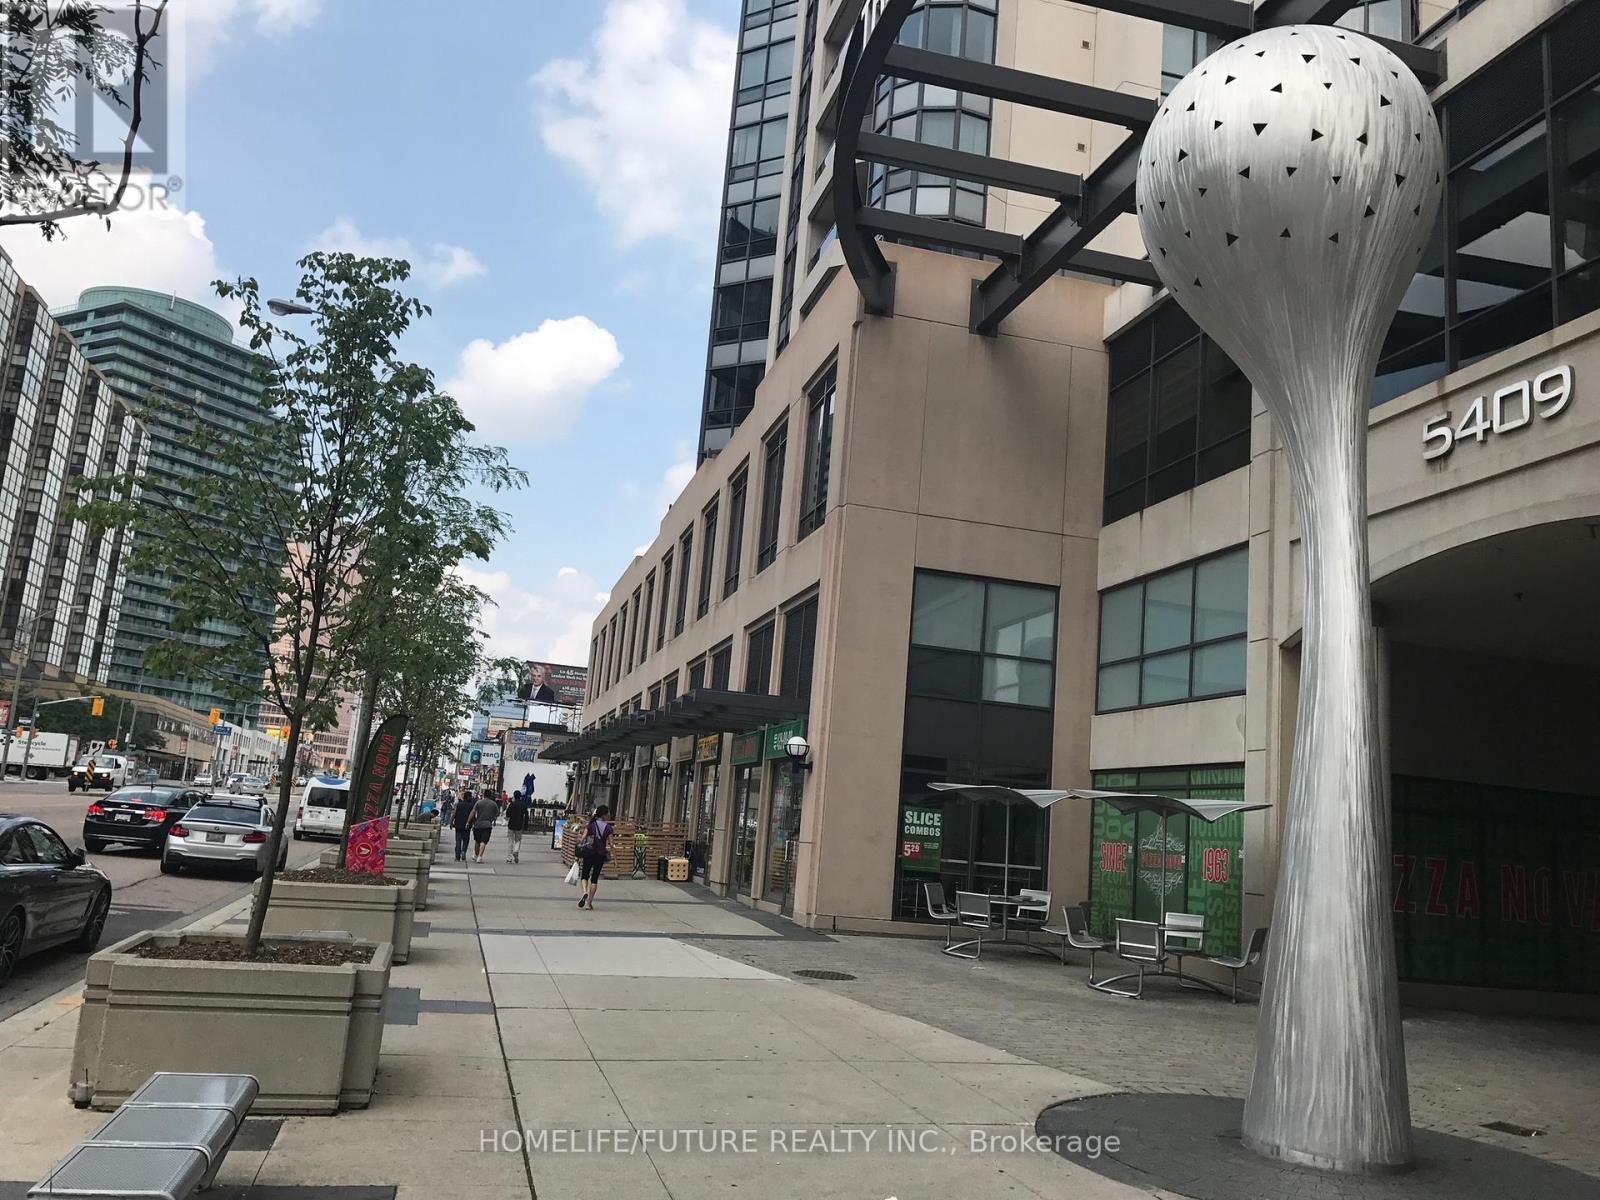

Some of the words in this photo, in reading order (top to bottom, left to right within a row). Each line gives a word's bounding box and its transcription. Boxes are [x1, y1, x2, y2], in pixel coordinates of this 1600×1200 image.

[1422, 364, 1574, 460] 5409
[372, 734, 397, 778] NOVA
[362, 783, 384, 821] IZZA
[905, 811, 942, 826] SLICE
[904, 825, 941, 837] COMBOS
[1100, 841, 1128, 873] SINCE
[1203, 847, 1231, 883] 1963
[1392, 854, 1481, 921] ZZA
